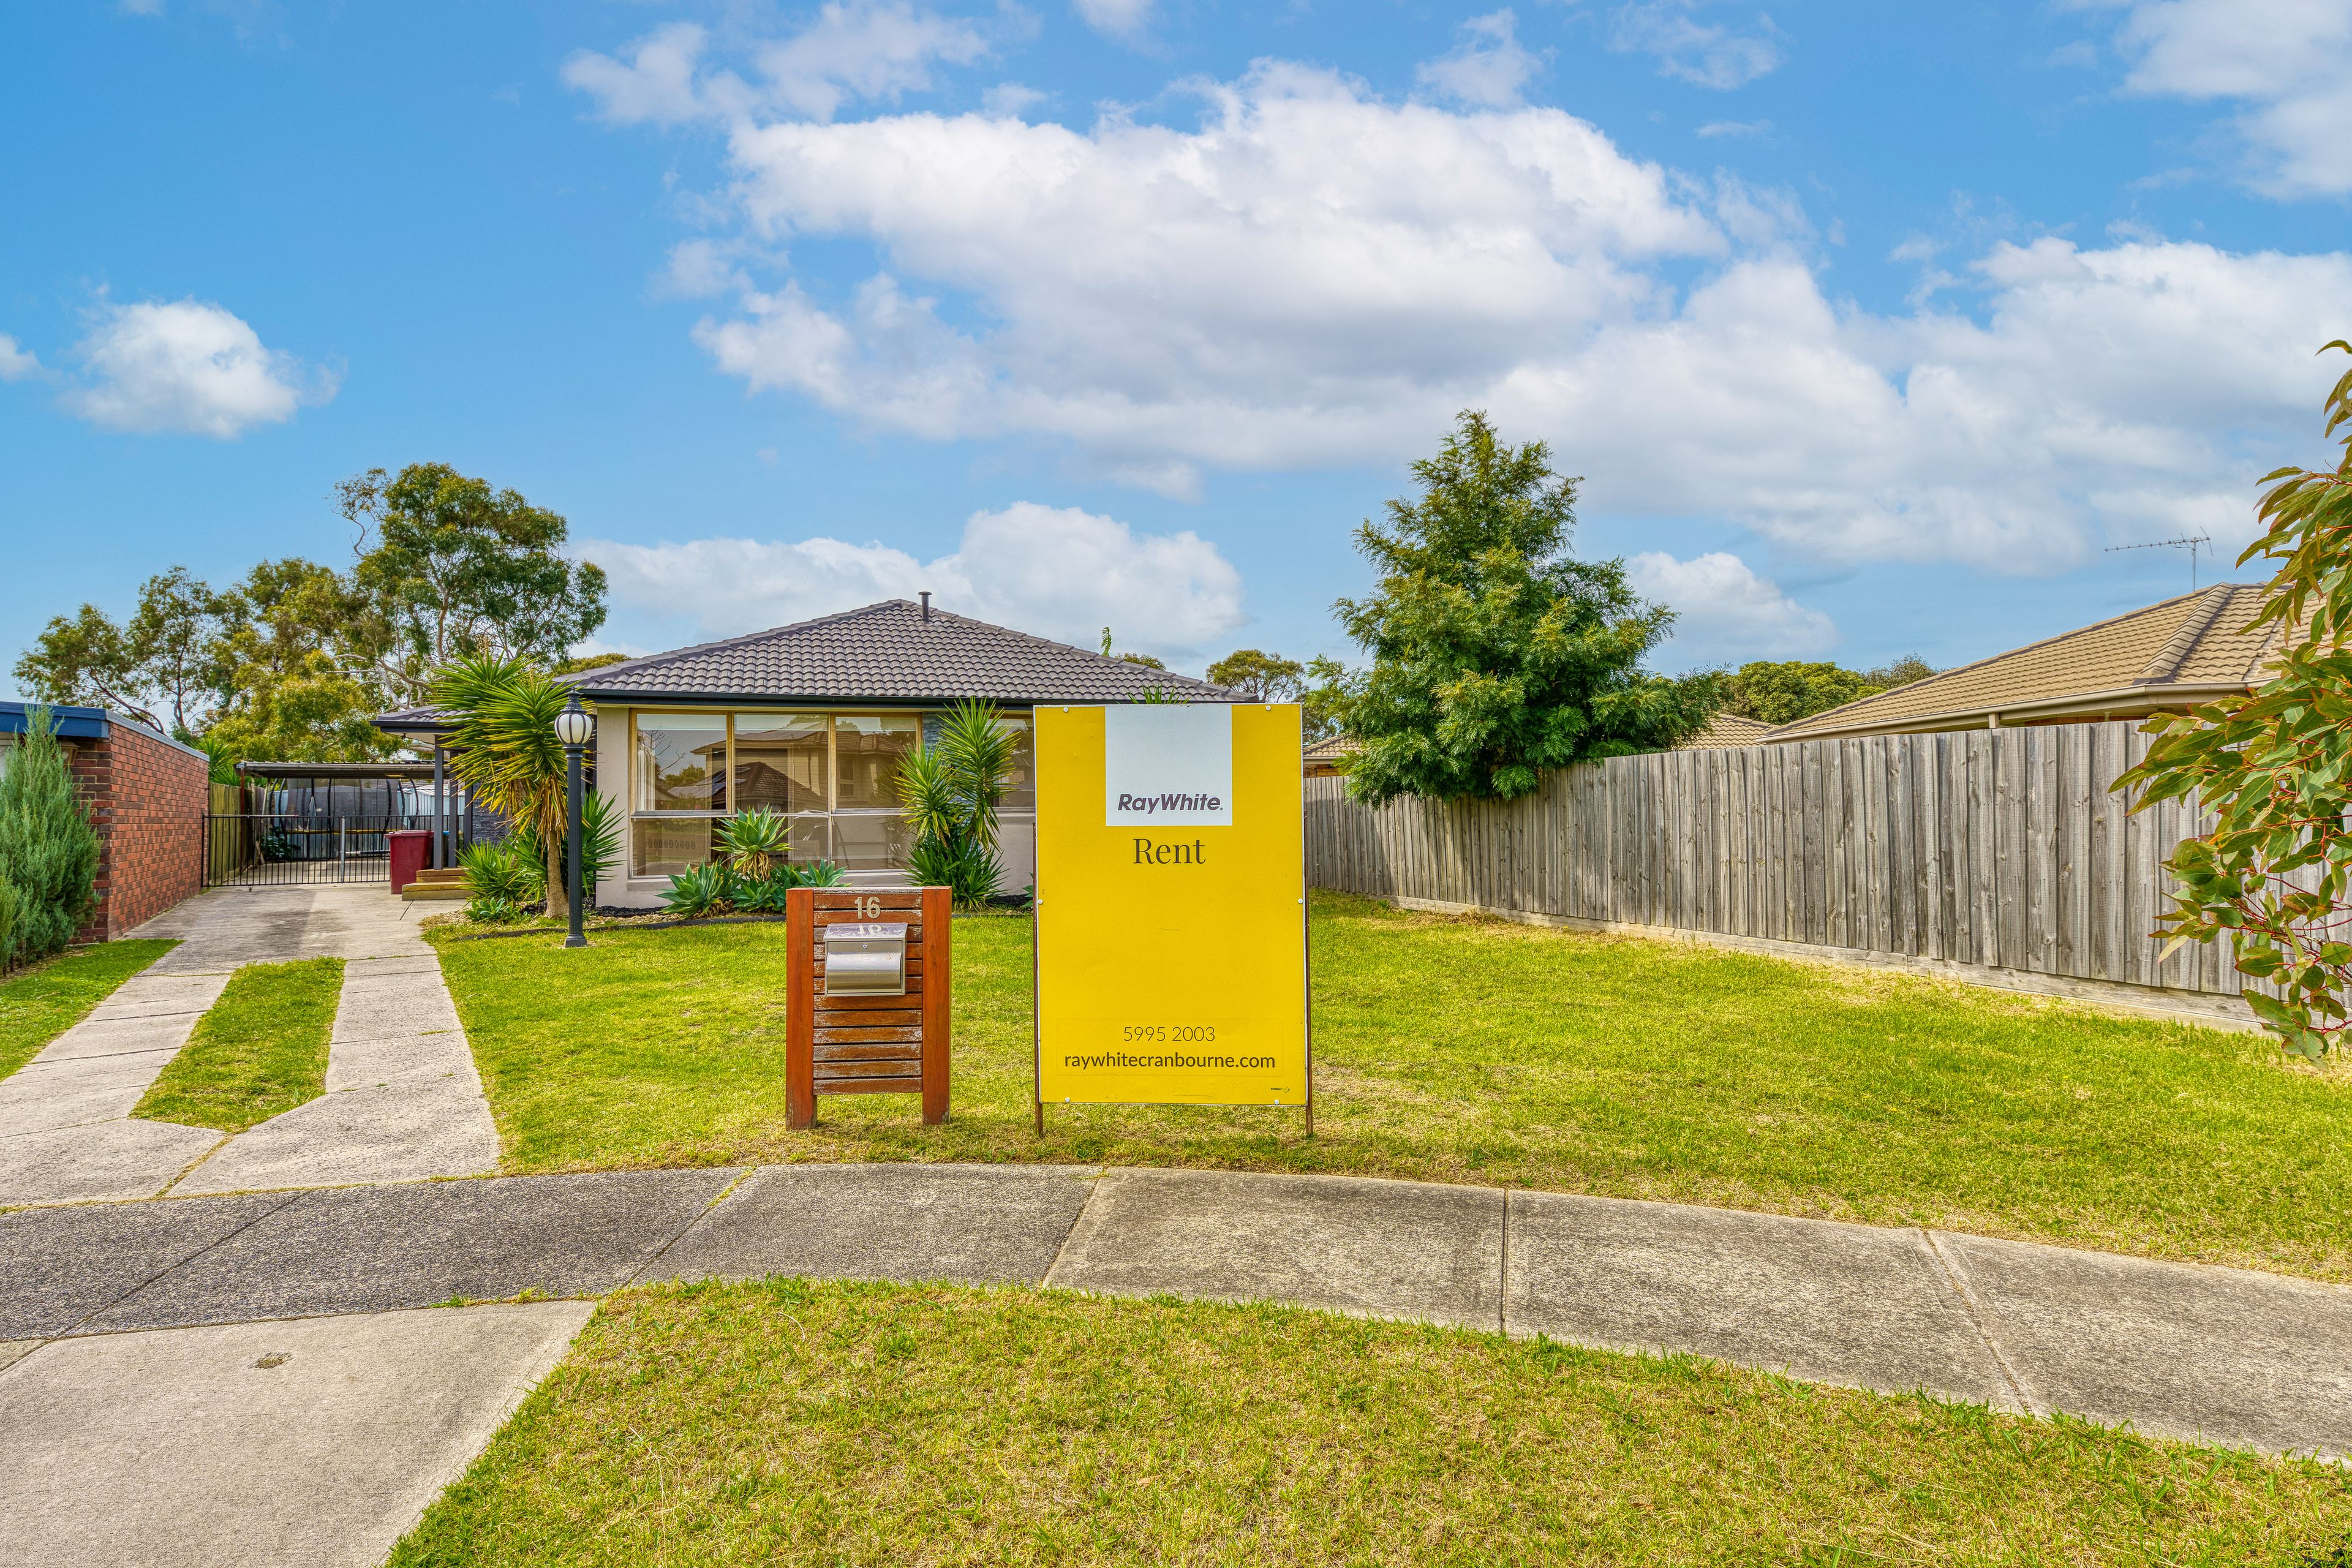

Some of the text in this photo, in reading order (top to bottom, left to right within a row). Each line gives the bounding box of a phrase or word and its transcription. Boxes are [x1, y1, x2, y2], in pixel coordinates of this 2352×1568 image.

[1133, 838, 1206, 864] Rent
[854, 896, 881, 919] 16
[1123, 1027, 1215, 1042] 5995 2003
[1065, 1051, 1275, 1070] raywhitecranbourne.com
